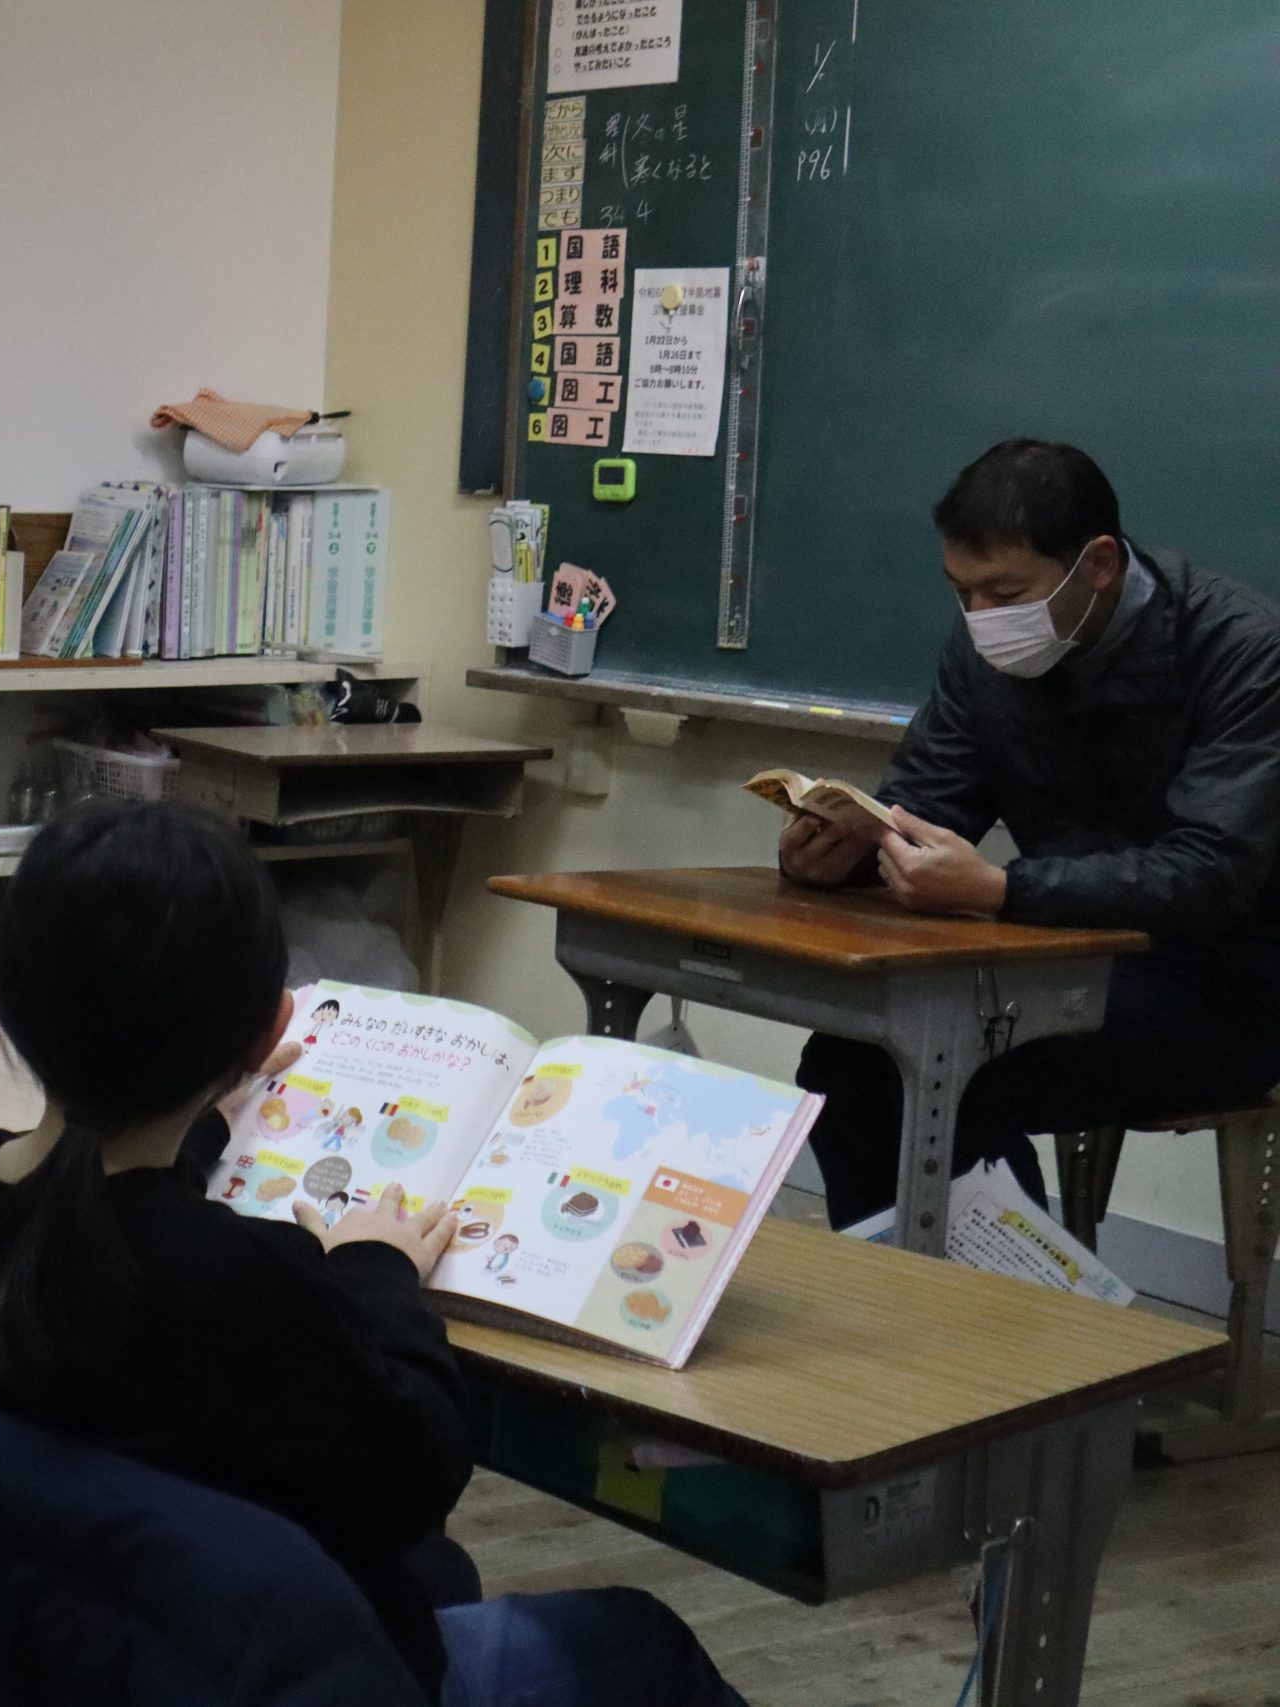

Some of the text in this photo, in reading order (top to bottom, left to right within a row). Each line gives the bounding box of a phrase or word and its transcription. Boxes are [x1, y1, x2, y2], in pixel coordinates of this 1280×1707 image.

[543, 165, 580, 182] まず
[541, 187, 581, 202] つまり
[544, 209, 579, 227] でも
[543, 234, 619, 261] 1 国語
[538, 268, 619, 295] 2 理科
[638, 286, 722, 298] 令和6半島地震
[536, 304, 614, 332] 3 算数
[534, 341, 614, 366] 4 国語
[561, 378, 615, 404] 図工
[532, 414, 604, 440] 6 図工
[340, 1012, 388, 1032] みんなの
[393, 1019, 448, 1043] だいすきな
